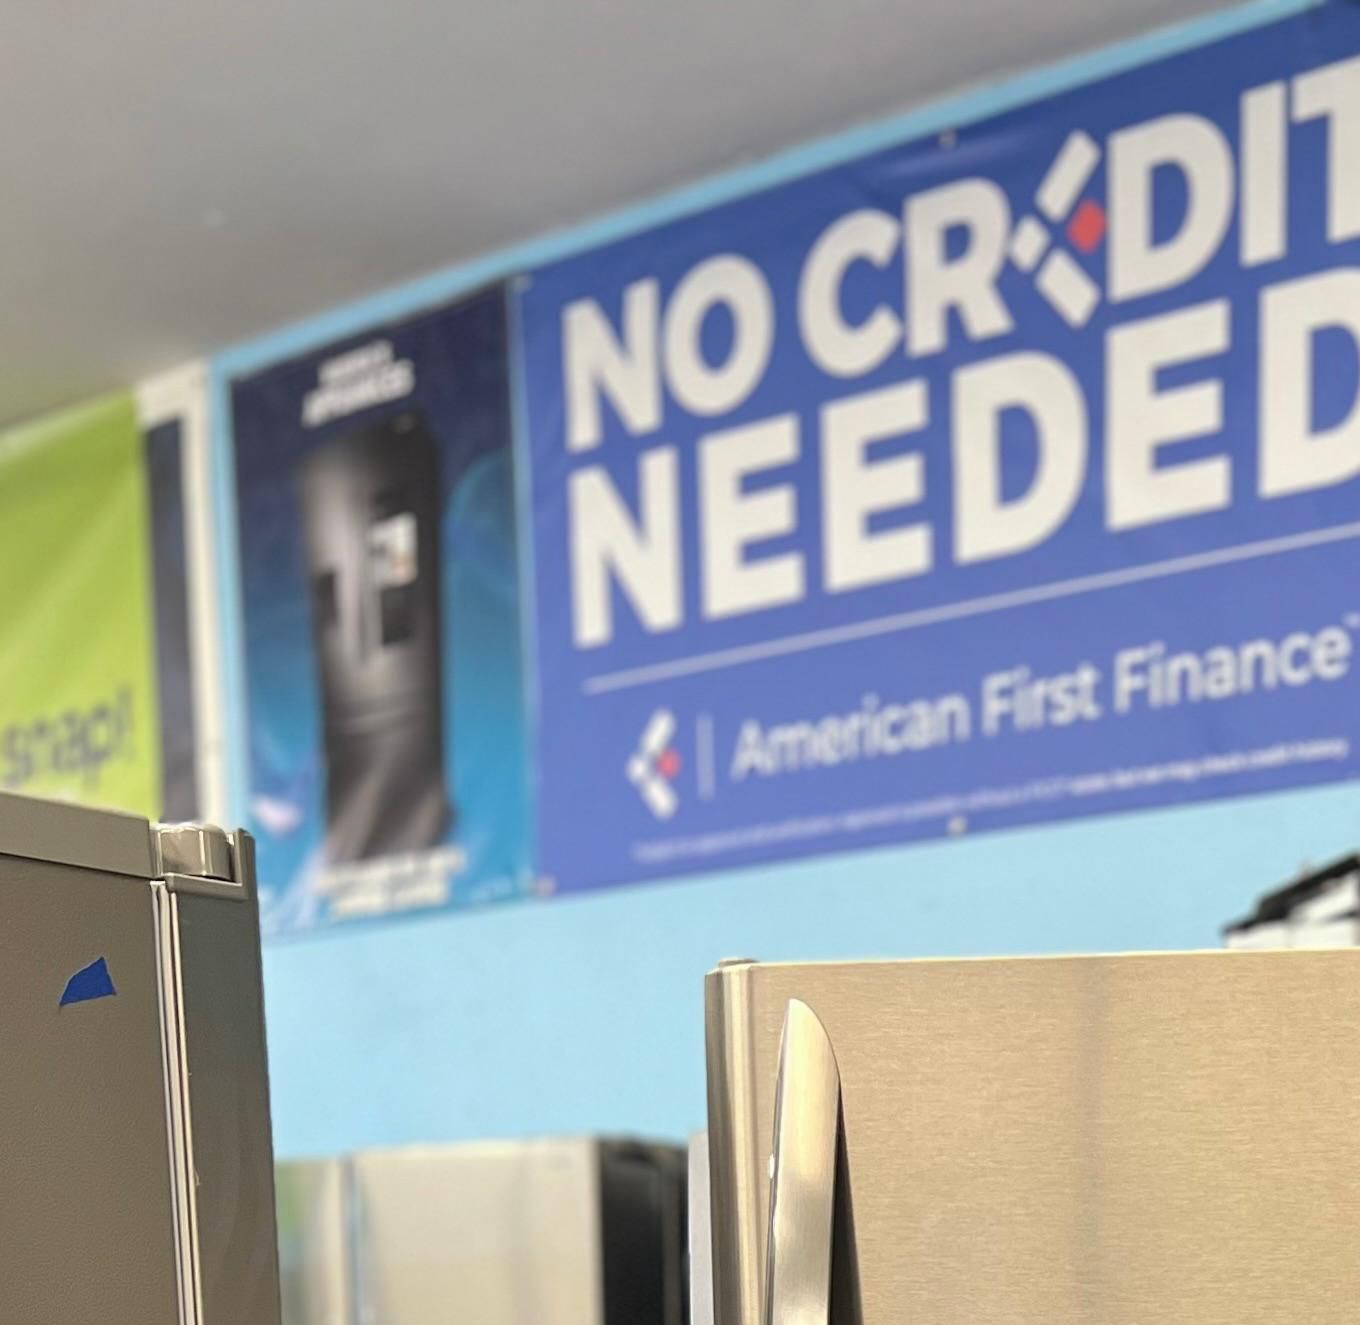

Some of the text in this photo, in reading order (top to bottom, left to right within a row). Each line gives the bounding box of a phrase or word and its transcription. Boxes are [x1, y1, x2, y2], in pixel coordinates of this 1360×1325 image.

[563, 253, 776, 454] NO
[731, 694, 971, 781] American
[981, 660, 1101, 736] First
